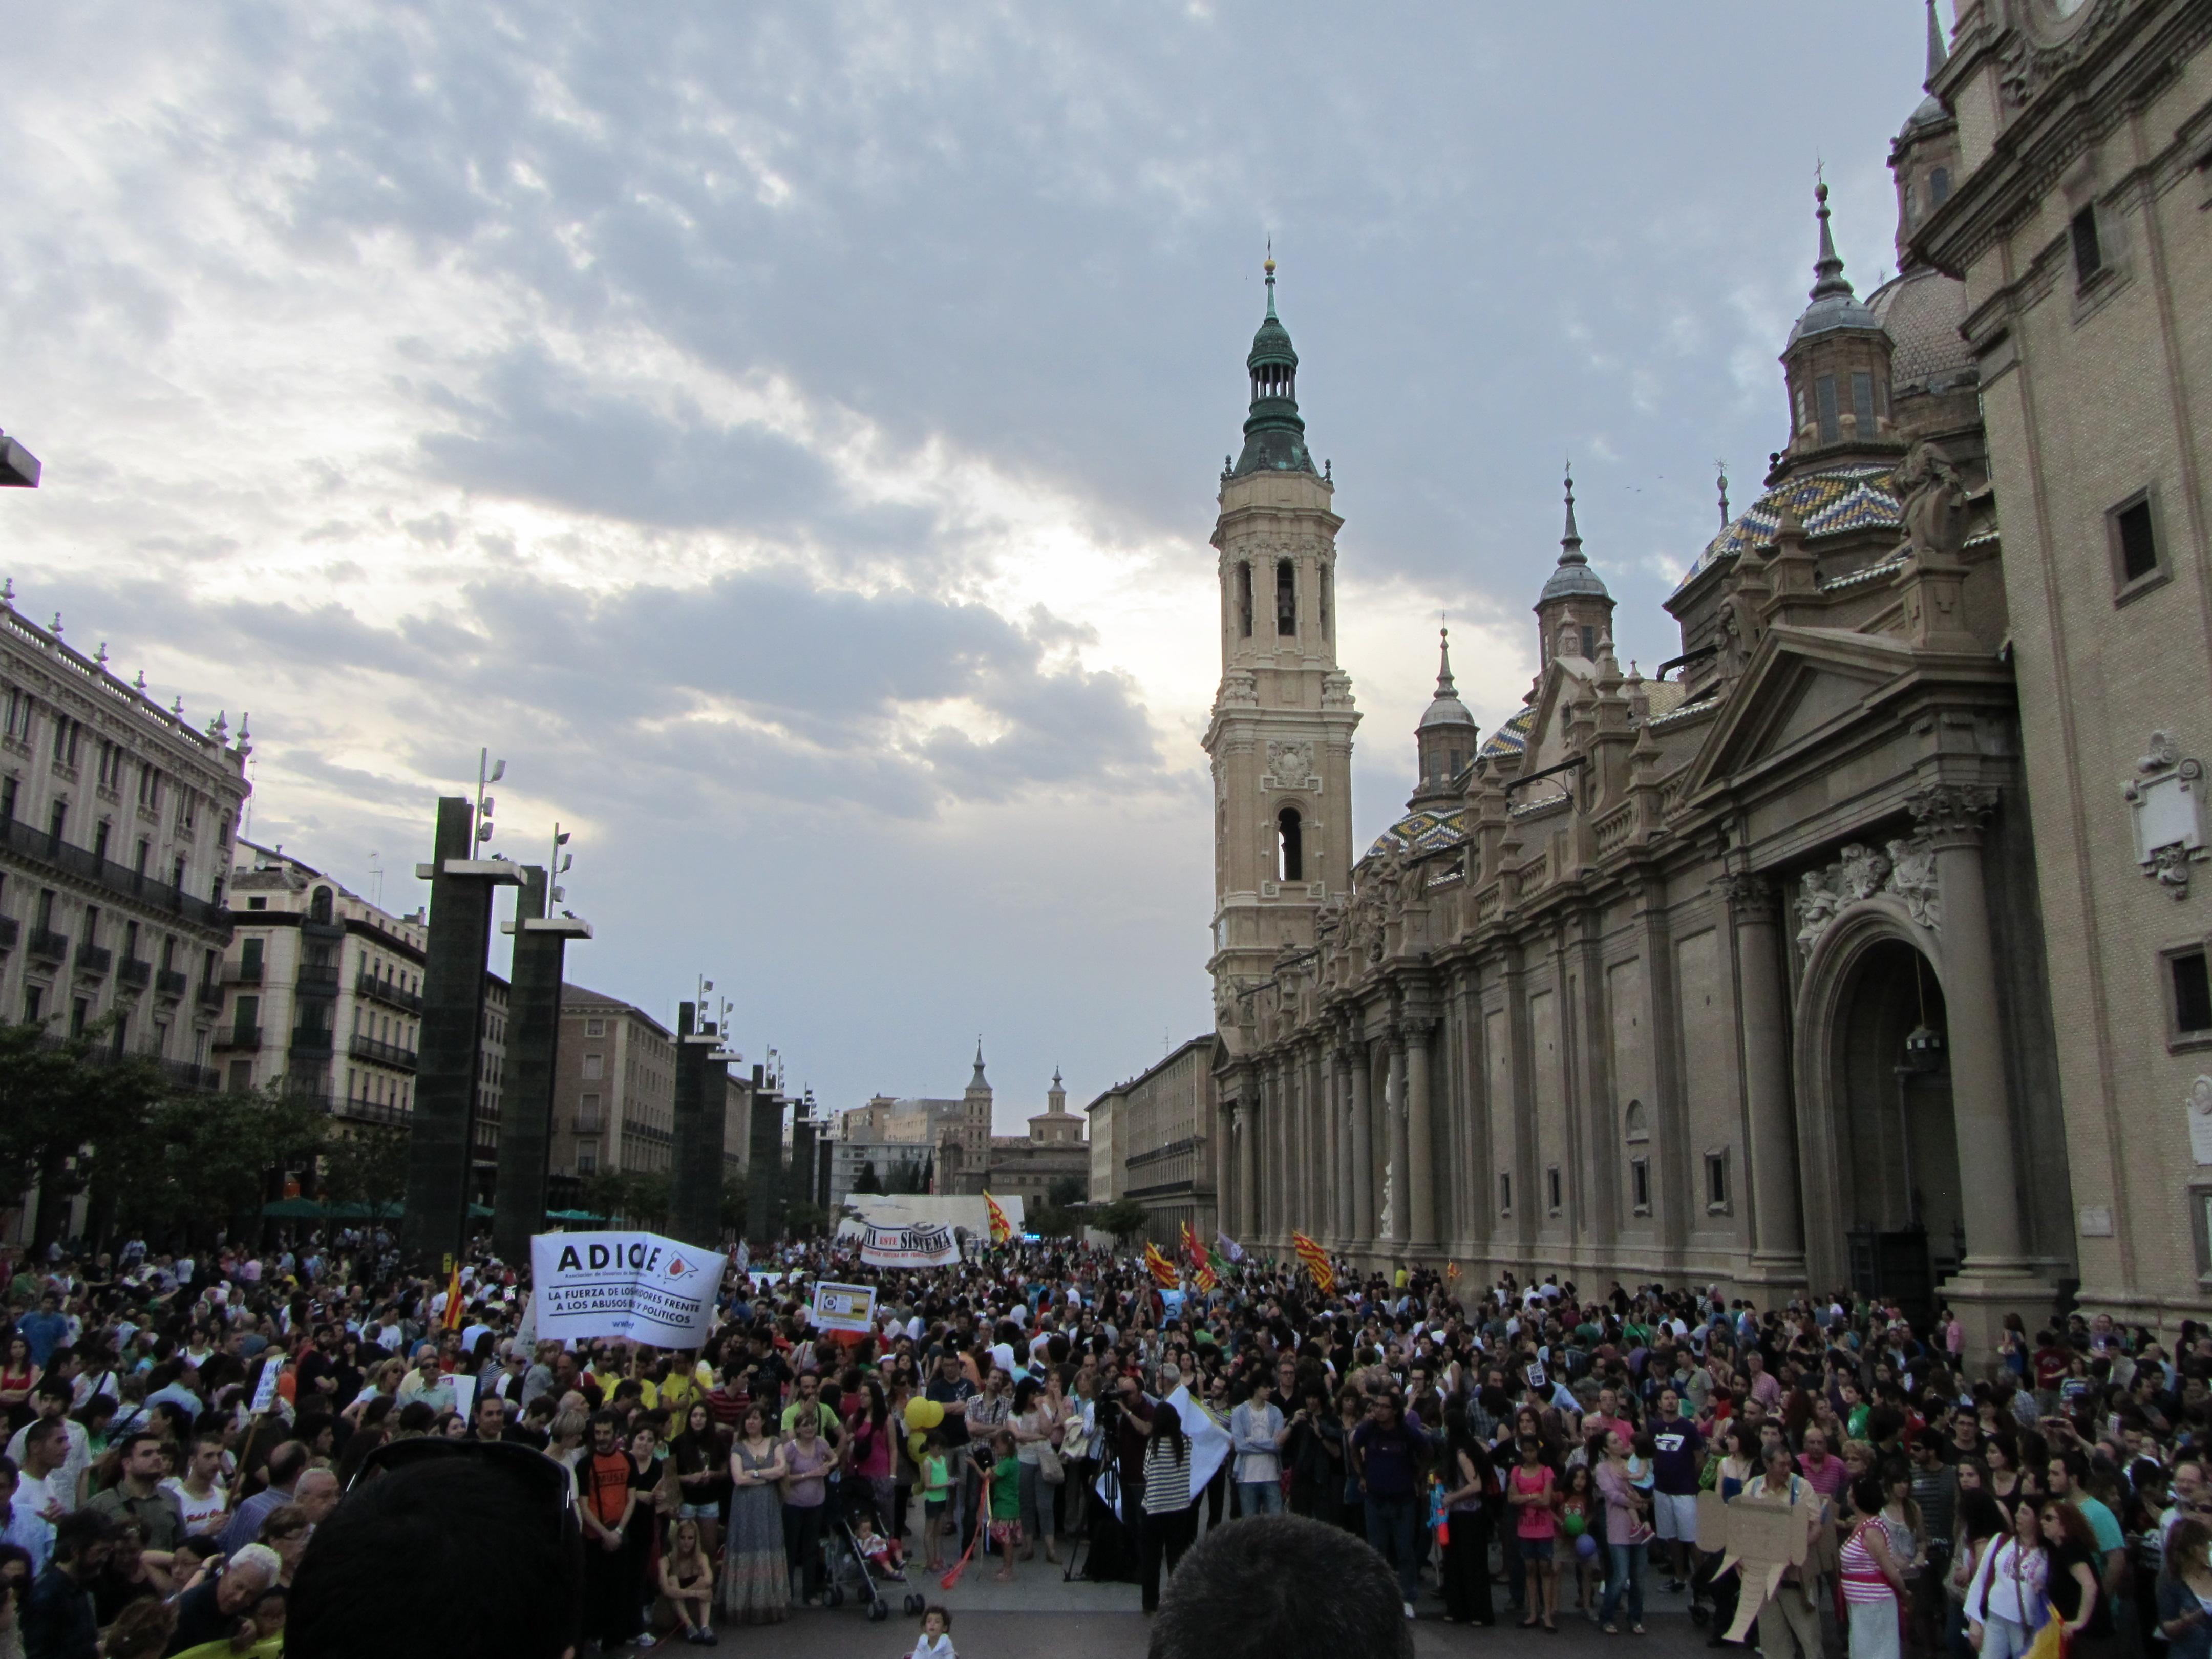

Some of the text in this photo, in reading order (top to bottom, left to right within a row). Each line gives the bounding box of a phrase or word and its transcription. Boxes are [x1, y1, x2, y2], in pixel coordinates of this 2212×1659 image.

[879, 1237, 897, 1245] ESTE
[900, 1231, 951, 1251] SISTEMA
[549, 1292, 561, 1300] LA
[565, 1288, 605, 1299] FUERZA
[608, 1288, 619, 1296] DE
[622, 1287, 634, 1295] LOS
[664, 1298, 700, 1312] FRENTE
[568, 1301, 588, 1310] LOS
[591, 1299, 627, 1308] ABUSOS
[642, 1305, 690, 1324] POLÍTICOS
